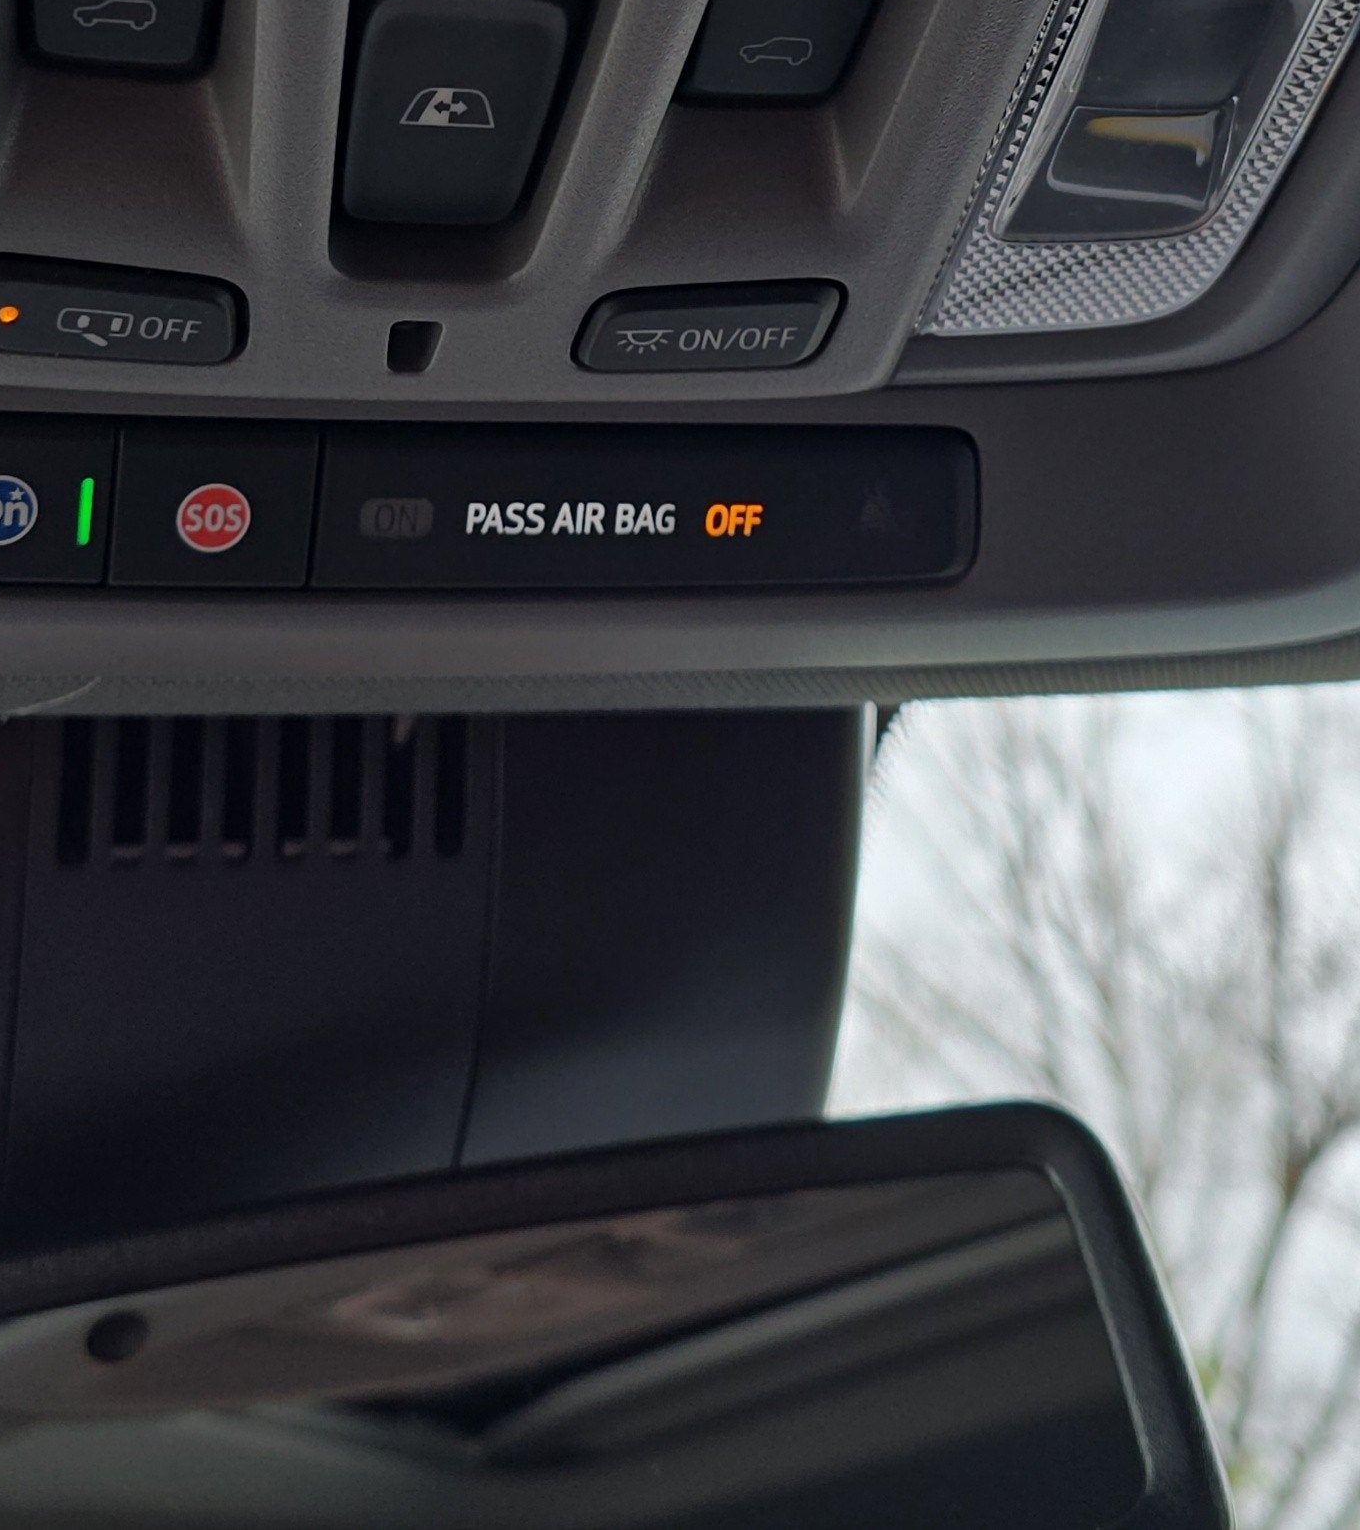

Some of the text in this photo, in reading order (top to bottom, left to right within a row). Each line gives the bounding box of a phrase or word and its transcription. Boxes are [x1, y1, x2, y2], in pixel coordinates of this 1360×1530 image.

[140, 315, 202, 343] OFF
[678, 327, 798, 352] ON/OFF
[183, 502, 243, 534] SOS
[373, 504, 419, 534] ON
[465, 501, 677, 536] PASS AIR BAG
[704, 503, 764, 537] OFF
